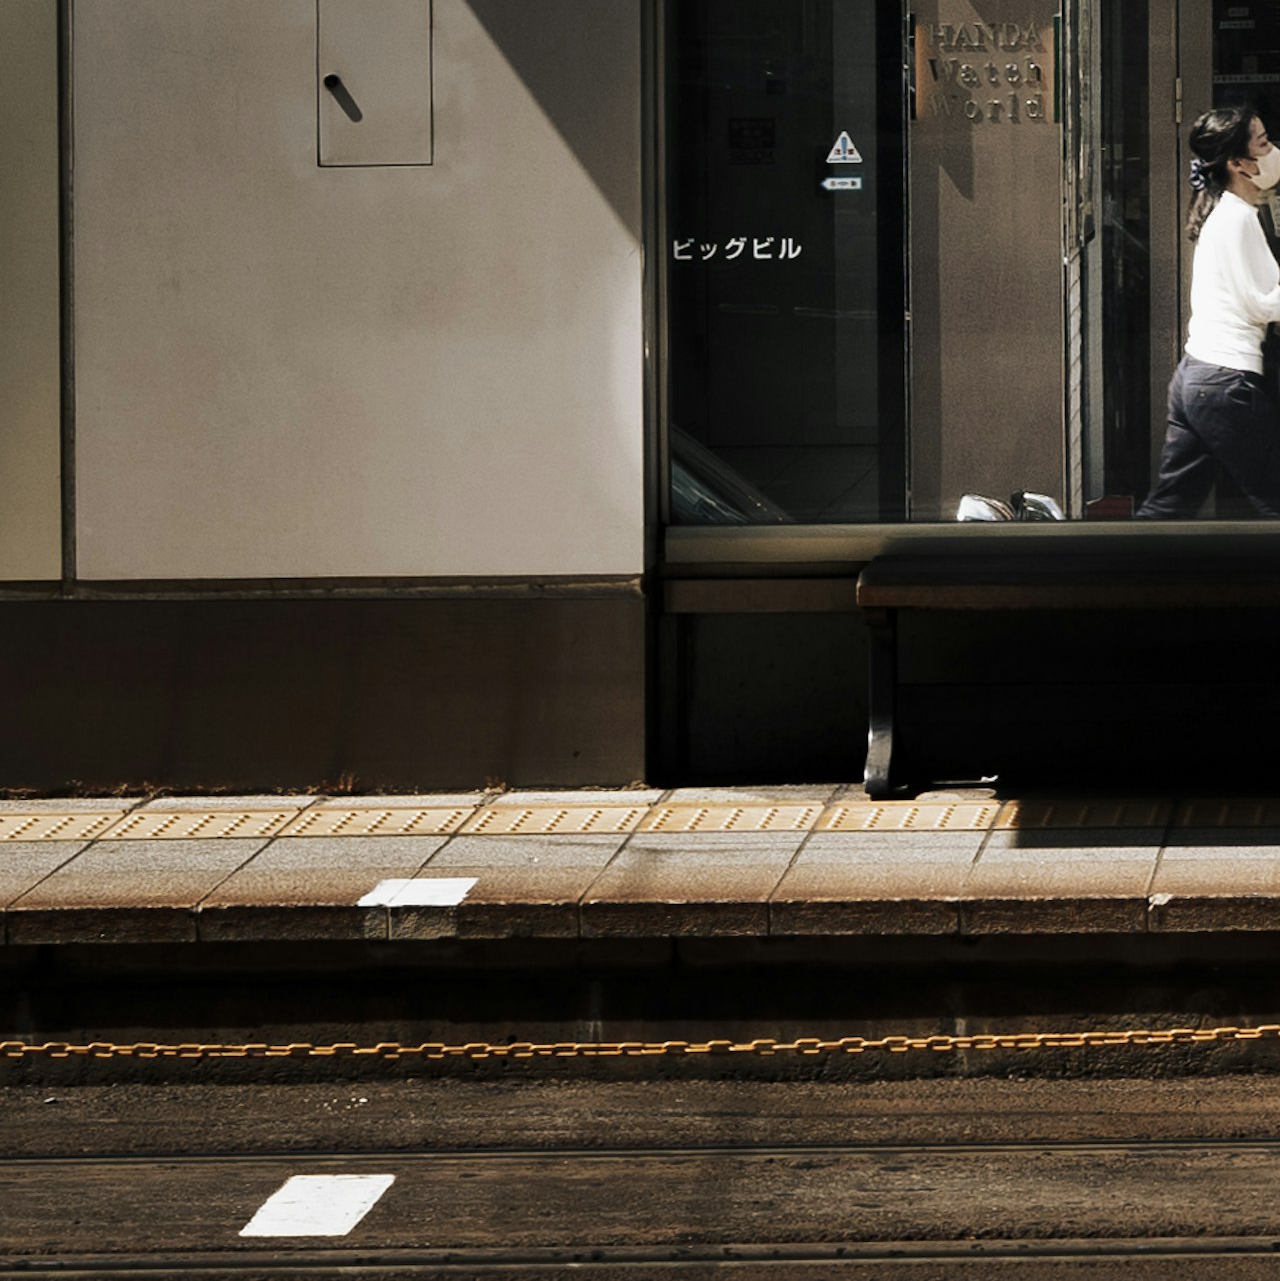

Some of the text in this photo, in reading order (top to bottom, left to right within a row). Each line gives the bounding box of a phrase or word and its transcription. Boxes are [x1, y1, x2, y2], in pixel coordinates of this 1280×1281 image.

[926, 21, 1043, 49] HANDA
[927, 56, 1043, 83] Watch
[929, 92, 1044, 119] World
[672, 237, 803, 262] ビッグビル
